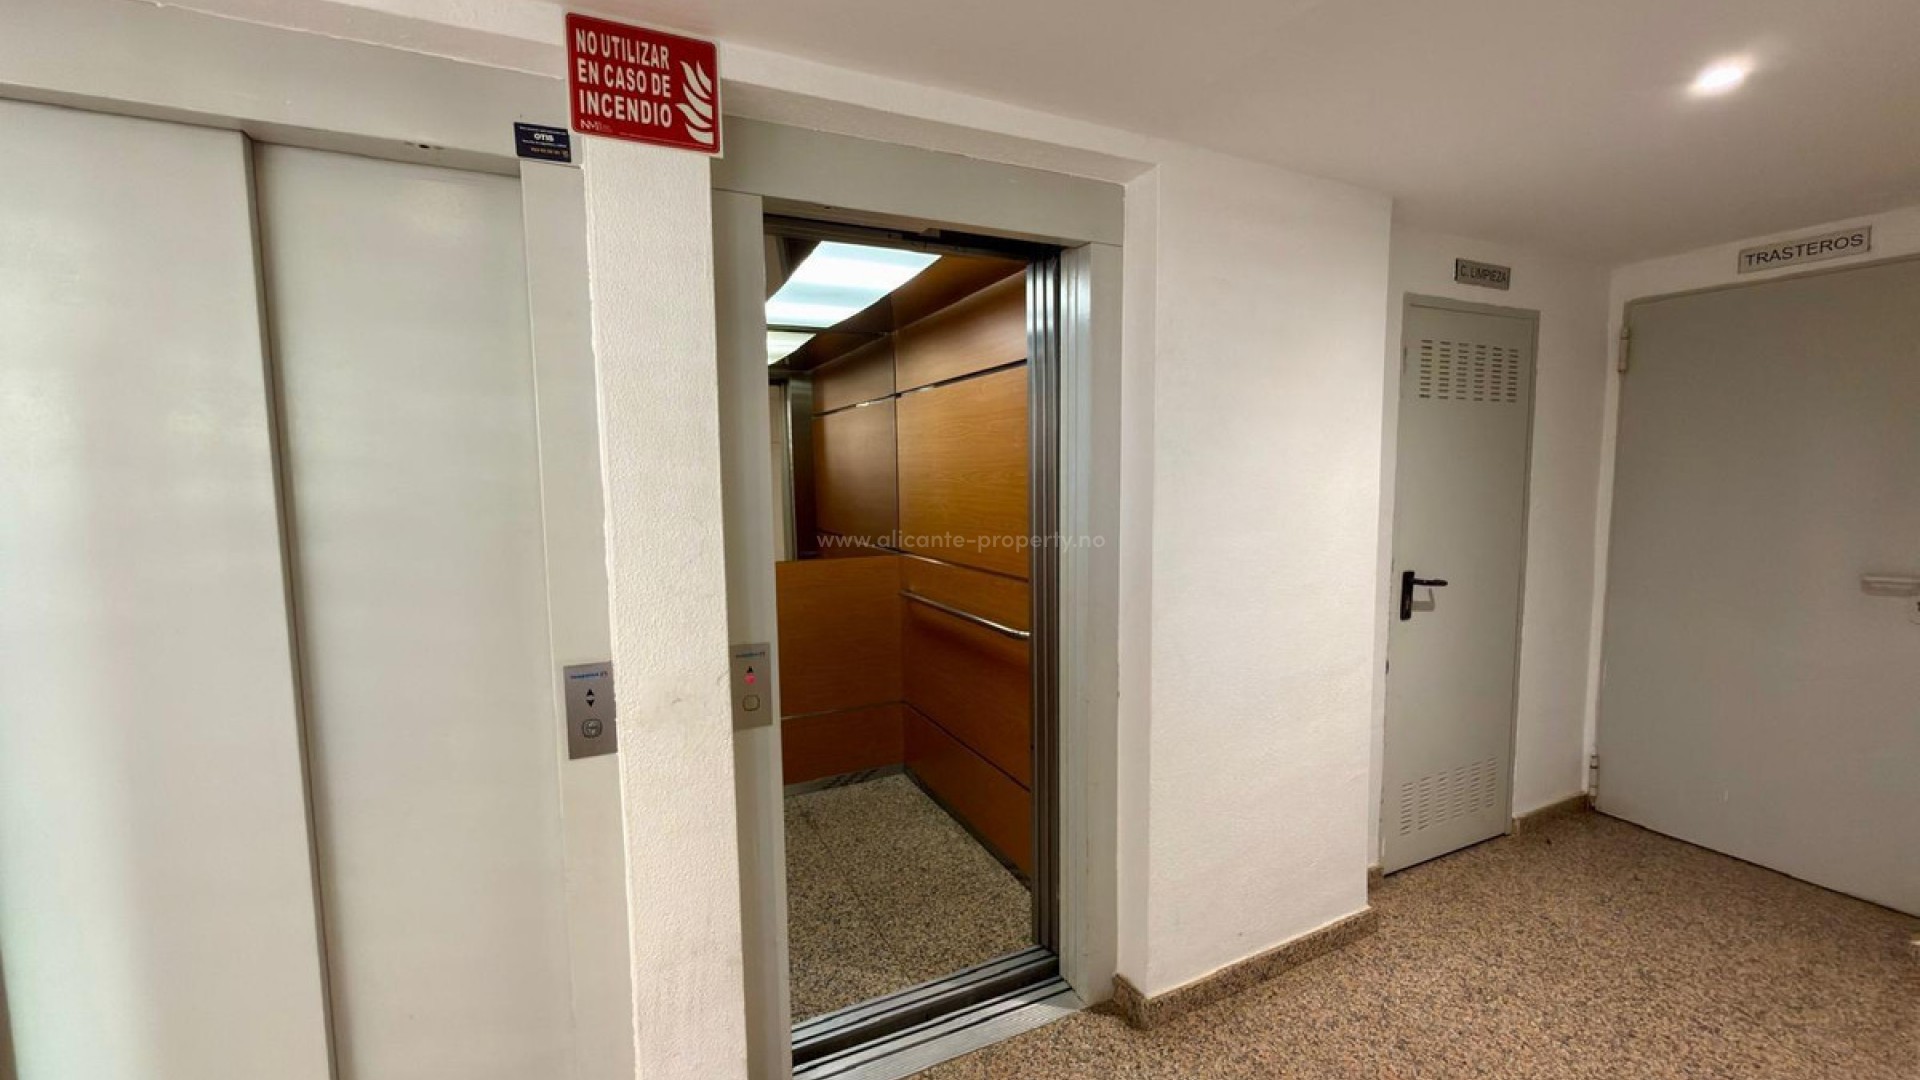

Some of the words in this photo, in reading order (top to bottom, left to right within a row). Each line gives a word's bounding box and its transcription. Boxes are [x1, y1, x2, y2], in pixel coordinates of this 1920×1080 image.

[576, 28, 597, 55] NO
[601, 34, 670, 70] UTILIZAR
[577, 58, 599, 85] EN
[604, 64, 647, 93] CASO
[651, 73, 671, 98] DE
[579, 89, 672, 128] INCENDIO
[1746, 233, 1863, 266] TRASTEROS
